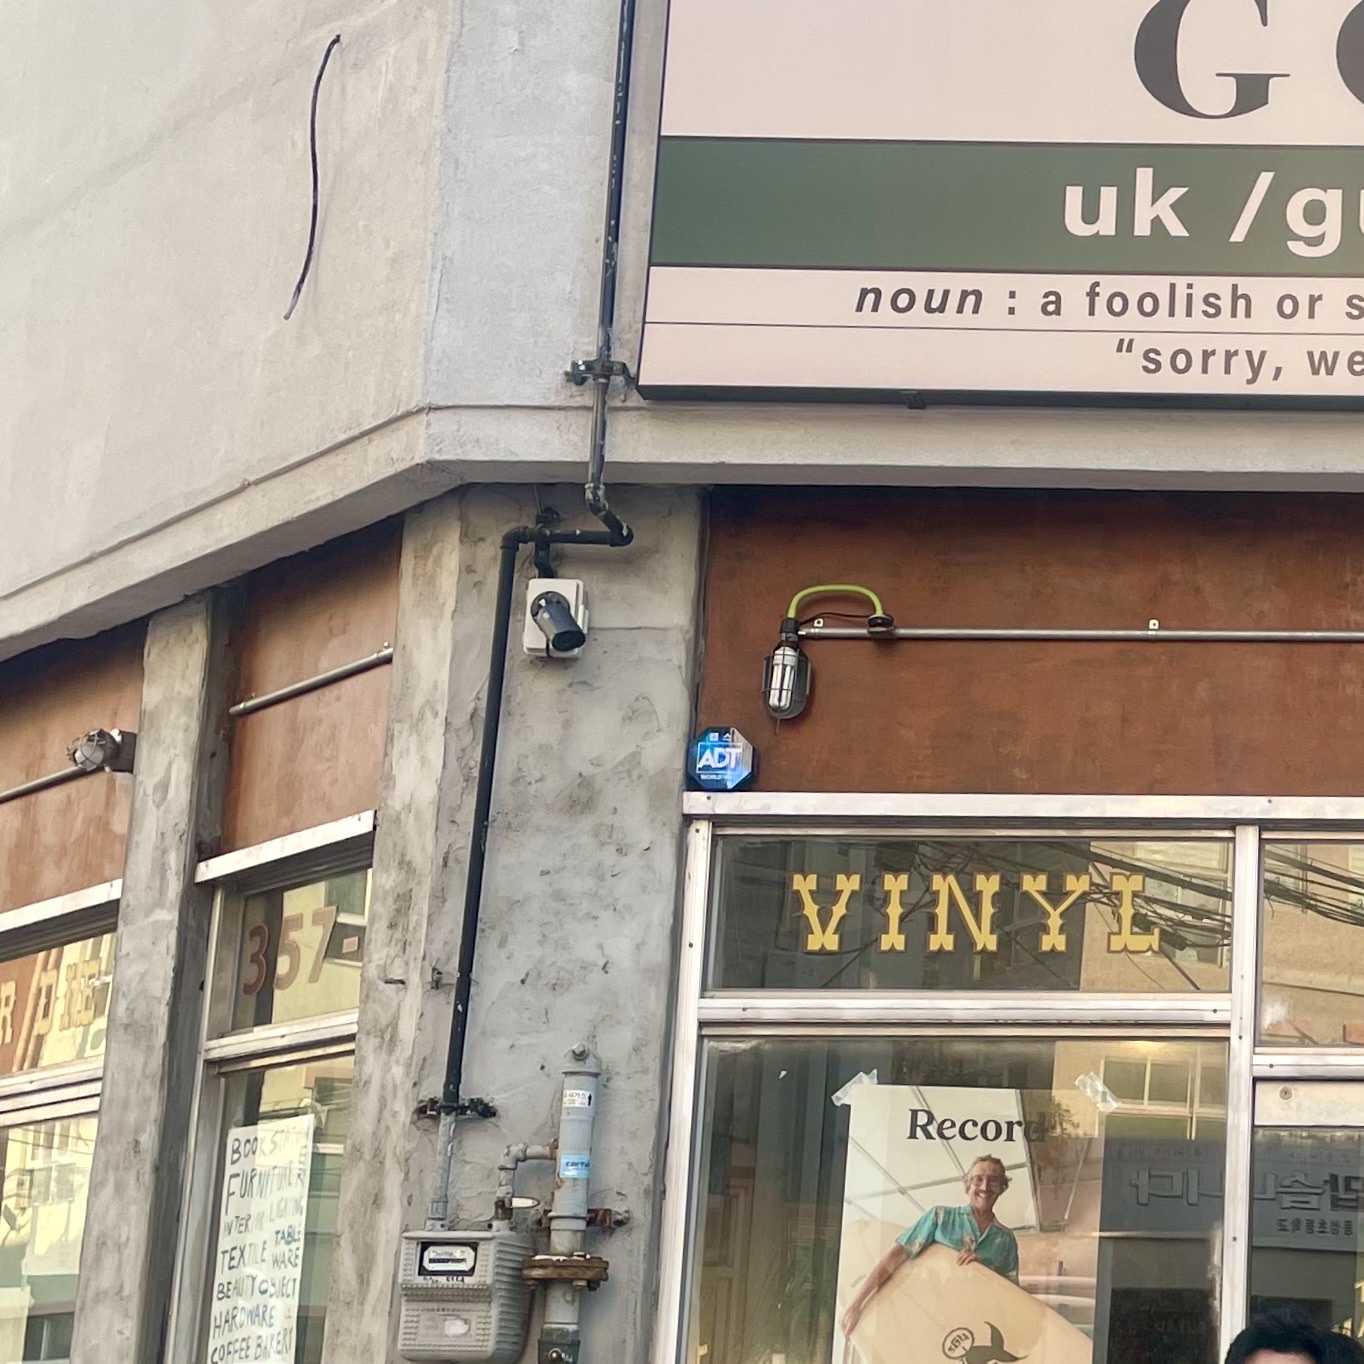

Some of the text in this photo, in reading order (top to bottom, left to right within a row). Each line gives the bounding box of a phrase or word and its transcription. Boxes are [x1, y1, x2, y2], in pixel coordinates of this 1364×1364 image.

[1063, 167, 1190, 238] uk
[854, 286, 984, 315] noun
[1040, 290, 1063, 317] a
[1085, 280, 1252, 320] foolish
[1276, 293, 1324, 320] or
[1115, 337, 1284, 386] "sorry,
[697, 746, 742, 769] ADT
[792, 873, 1161, 953] VINYL
[907, 1109, 1046, 1143] Record
[230, 1134, 268, 1166] BOOK
[271, 1245, 300, 1271] WARE
[217, 1274, 257, 1301] BEAUTY
[213, 1303, 276, 1340] HARDWARE
